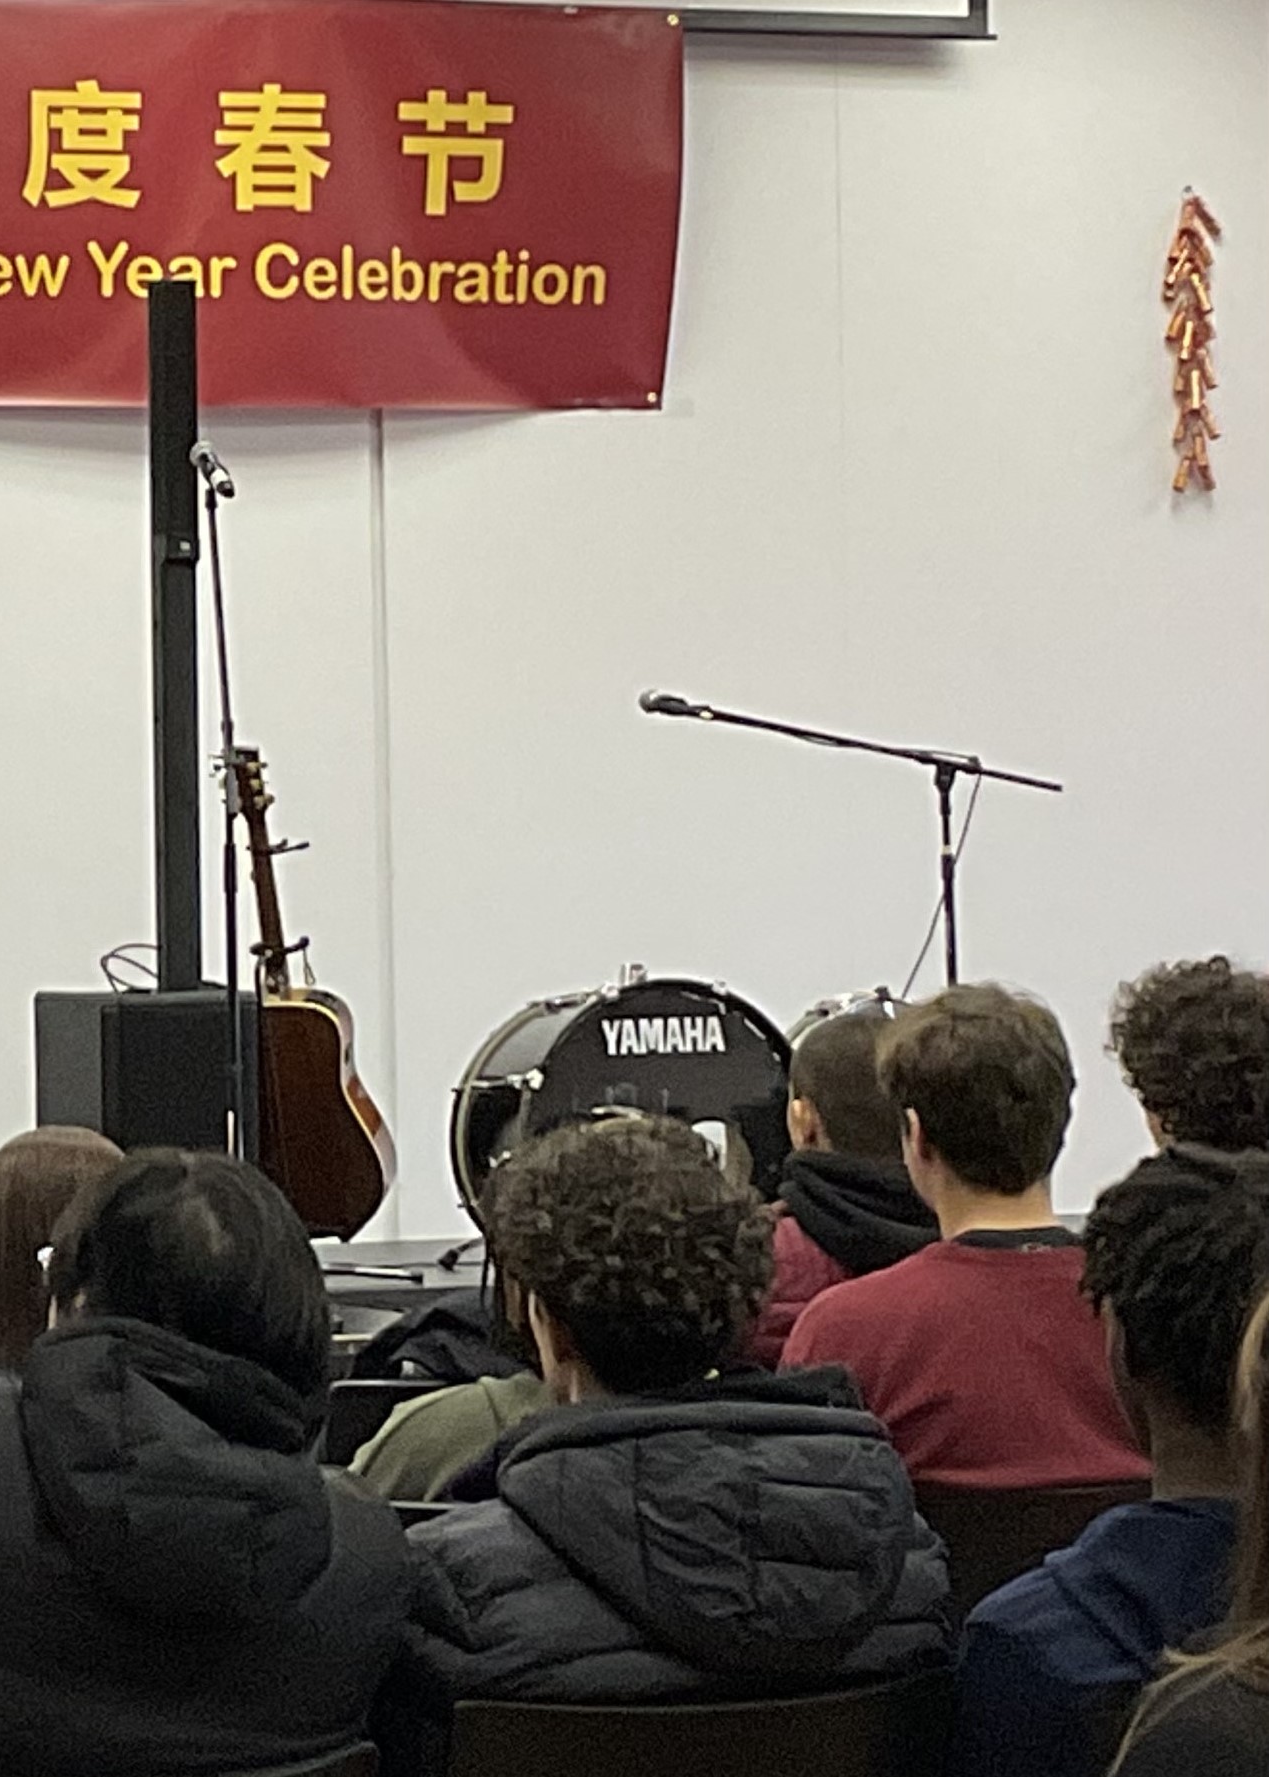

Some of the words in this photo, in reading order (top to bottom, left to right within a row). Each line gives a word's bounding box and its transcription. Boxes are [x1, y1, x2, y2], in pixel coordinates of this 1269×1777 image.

[86, 240, 238, 299] Year
[254, 241, 607, 306] Celebration
[601, 1015, 726, 1056] YAMAHA
